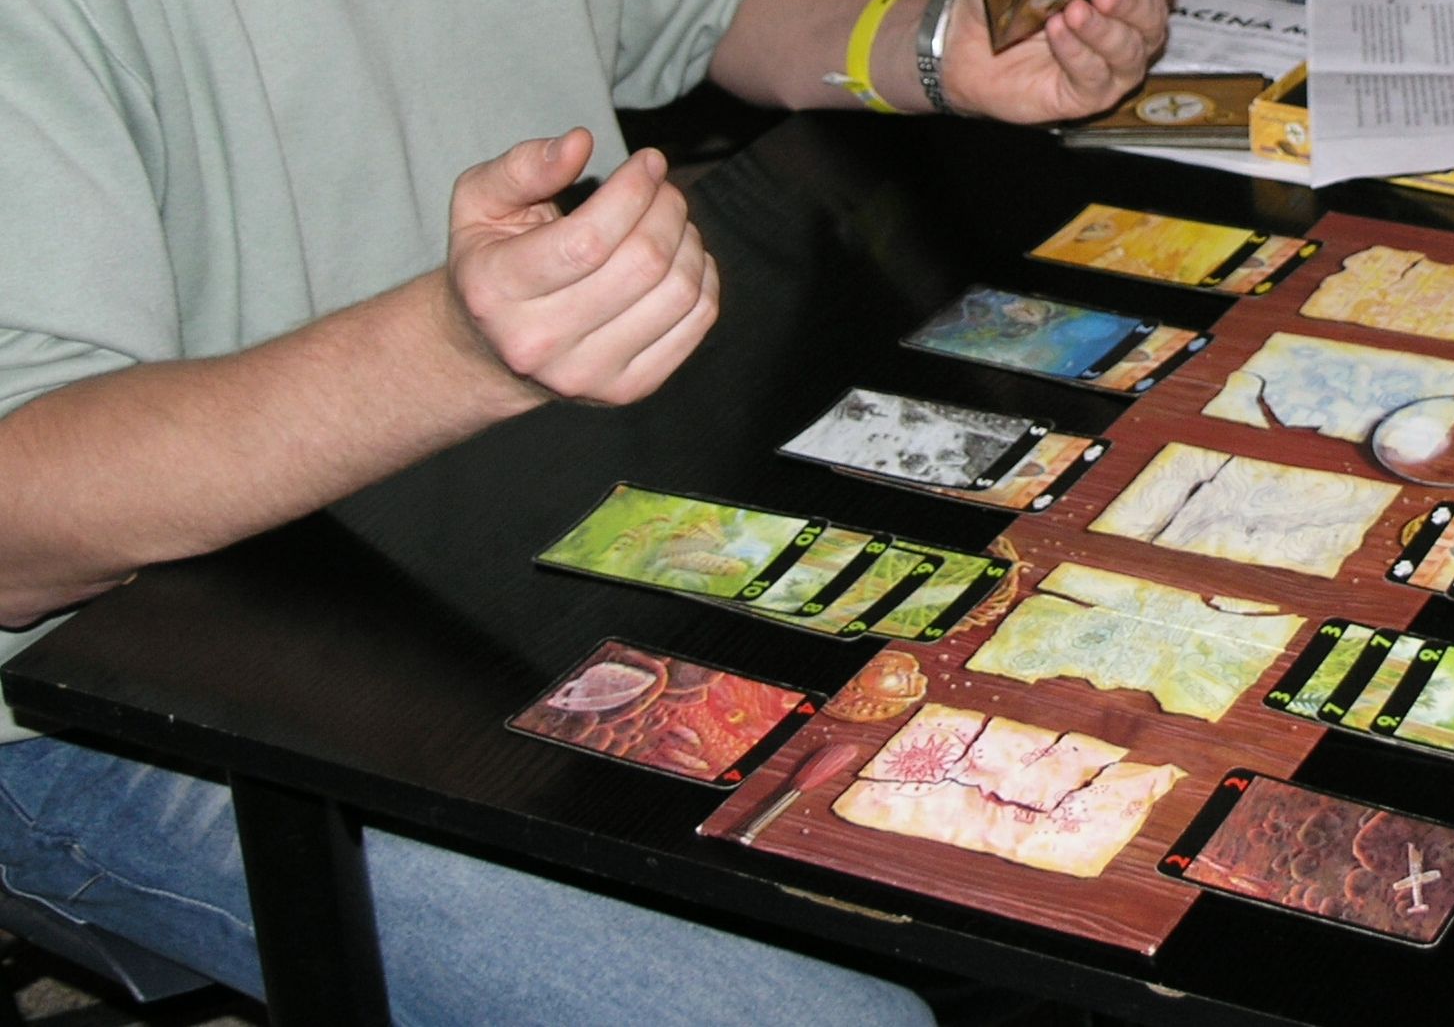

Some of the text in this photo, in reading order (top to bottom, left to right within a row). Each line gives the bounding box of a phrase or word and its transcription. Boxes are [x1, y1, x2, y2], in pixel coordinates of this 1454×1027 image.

[796, 526, 821, 546] 10
[865, 541, 887, 555] 8
[742, 579, 770, 598] 10
[803, 602, 824, 614] 8
[1320, 624, 1342, 639] 3
[1371, 634, 1392, 648] 7
[1269, 690, 1291, 703] 3
[1322, 701, 1345, 717] 7
